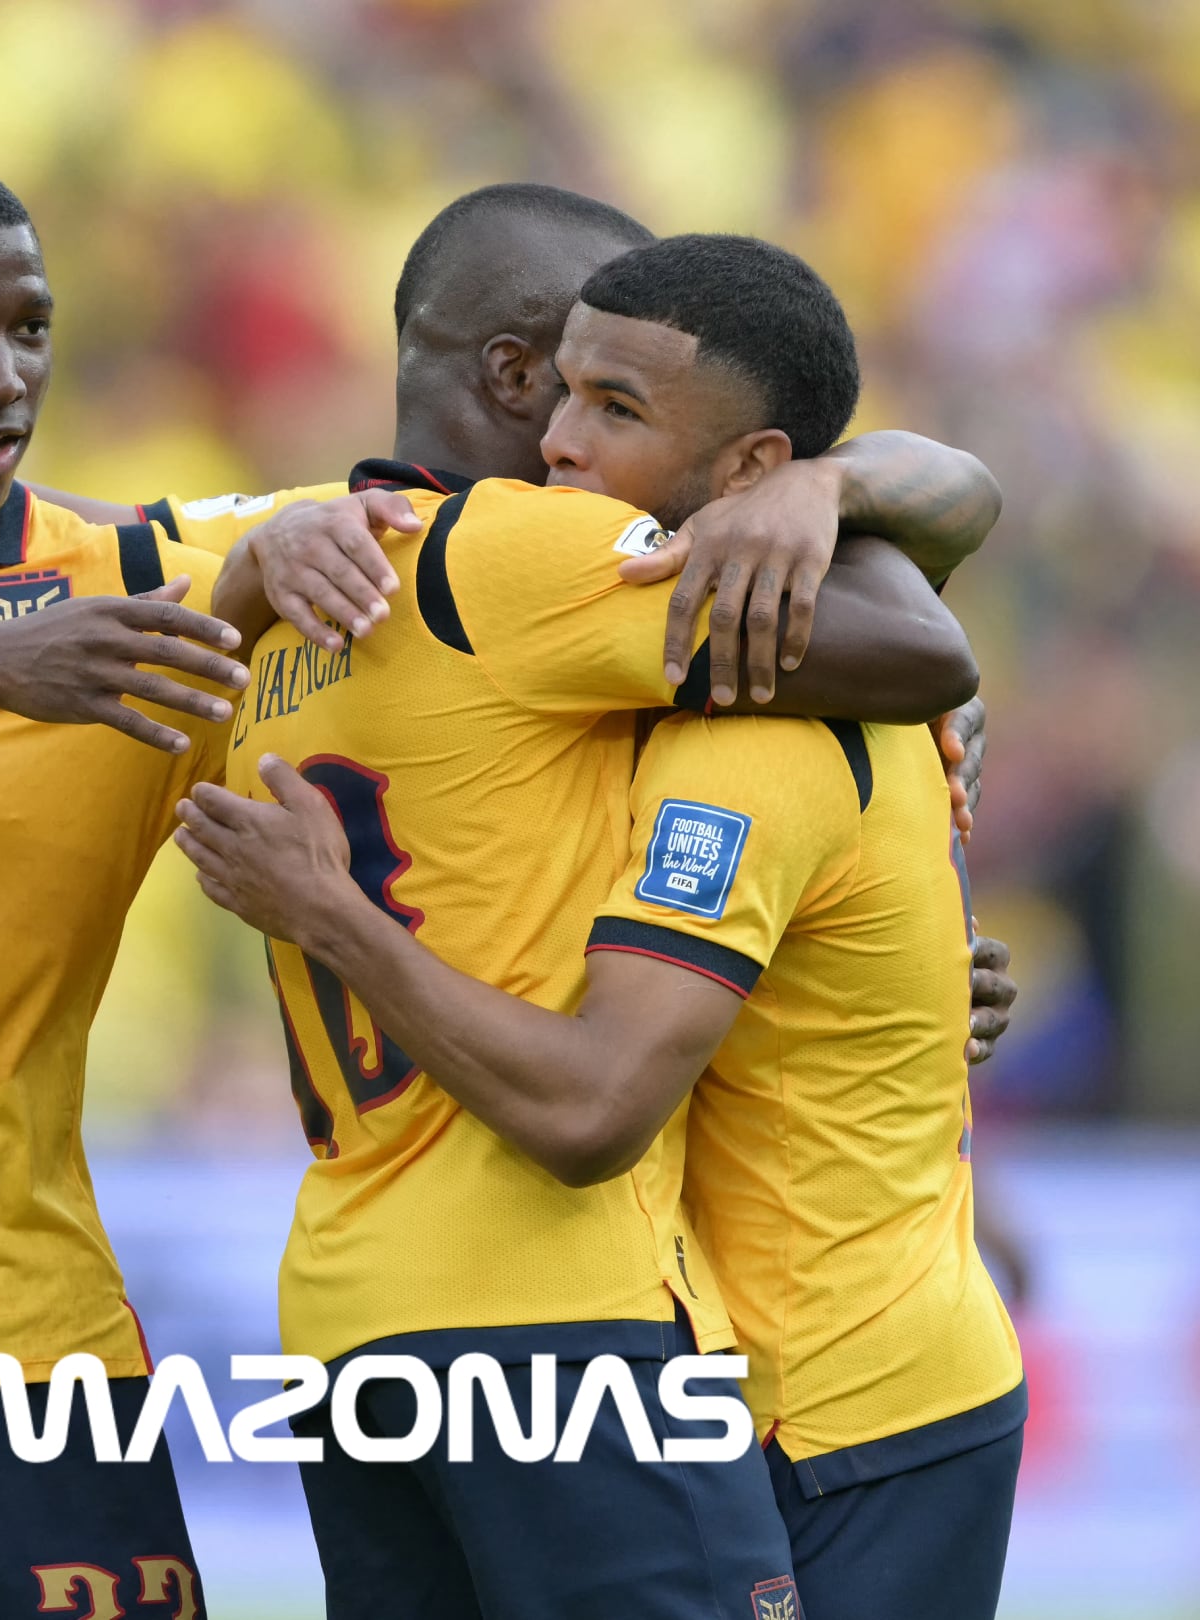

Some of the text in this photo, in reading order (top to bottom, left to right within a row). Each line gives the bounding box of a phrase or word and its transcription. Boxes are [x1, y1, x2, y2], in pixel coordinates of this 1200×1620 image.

[672, 817, 723, 842] FOOTBALL
[667, 832, 721, 861] UNITES
[662, 852, 720, 880] the World
[671, 877, 693, 889] FIFA
